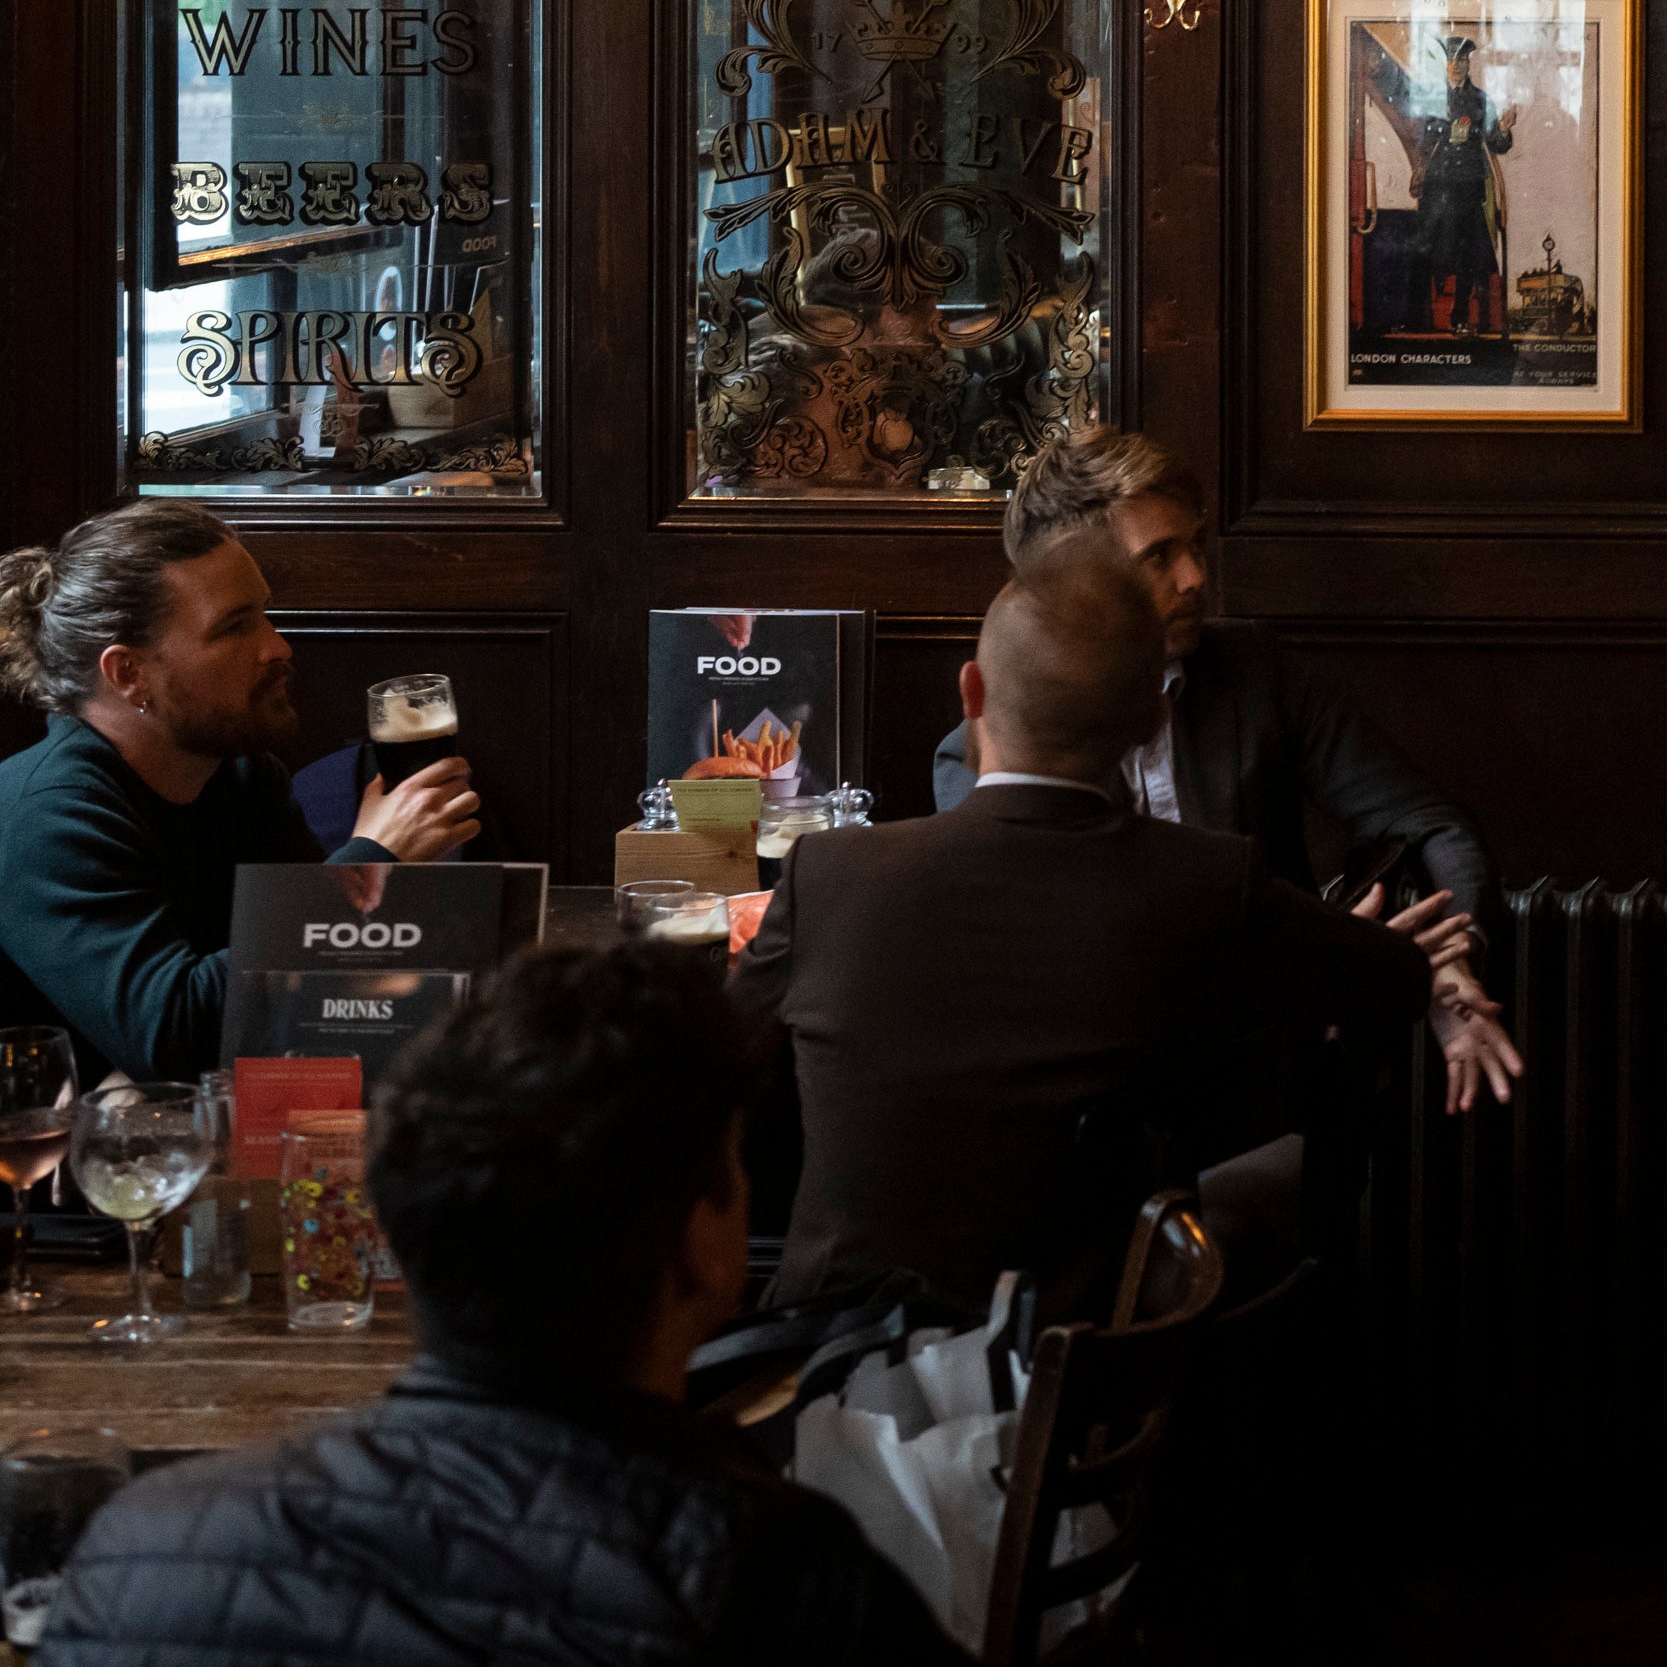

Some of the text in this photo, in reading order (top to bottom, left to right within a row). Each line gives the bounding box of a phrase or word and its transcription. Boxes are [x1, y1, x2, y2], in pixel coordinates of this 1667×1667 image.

[180, 8, 479, 77] WINES
[707, 108, 1093, 185] ADAM & EVE
[170, 161, 493, 226] BEERS
[177, 309, 484, 397] SPIRITS
[1350, 353, 1472, 365] LONDON CHARACTERS
[1512, 343, 1597, 353] THE CONDUCTOR
[697, 656, 782, 675] FOOD
[302, 922, 423, 949] FOOD
[322, 998, 394, 1021] DRINKS
